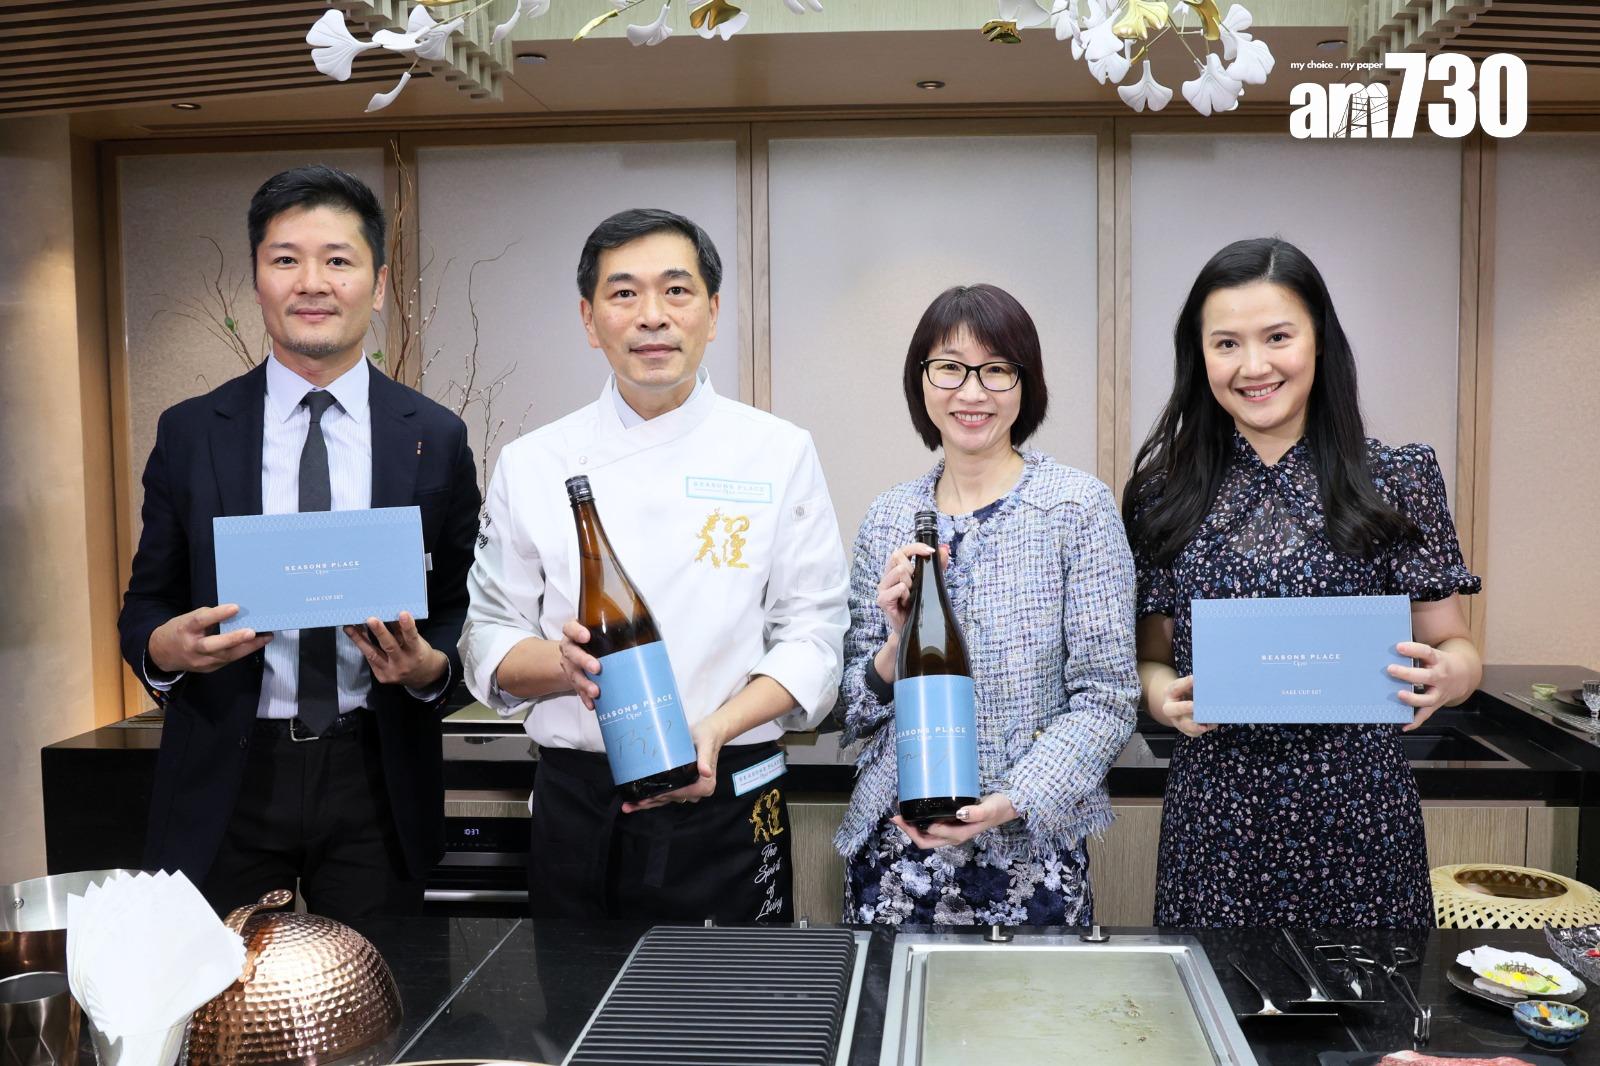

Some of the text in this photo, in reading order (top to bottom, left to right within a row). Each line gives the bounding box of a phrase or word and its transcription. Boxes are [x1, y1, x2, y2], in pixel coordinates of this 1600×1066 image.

[285, 560, 360, 571] SEASONS PLACE
[643, 694, 673, 706] PACE
[760, 842, 778, 863] The
[754, 856, 783, 884] Spirit
[766, 878, 776, 897] of
[754, 896, 783, 921] Living
